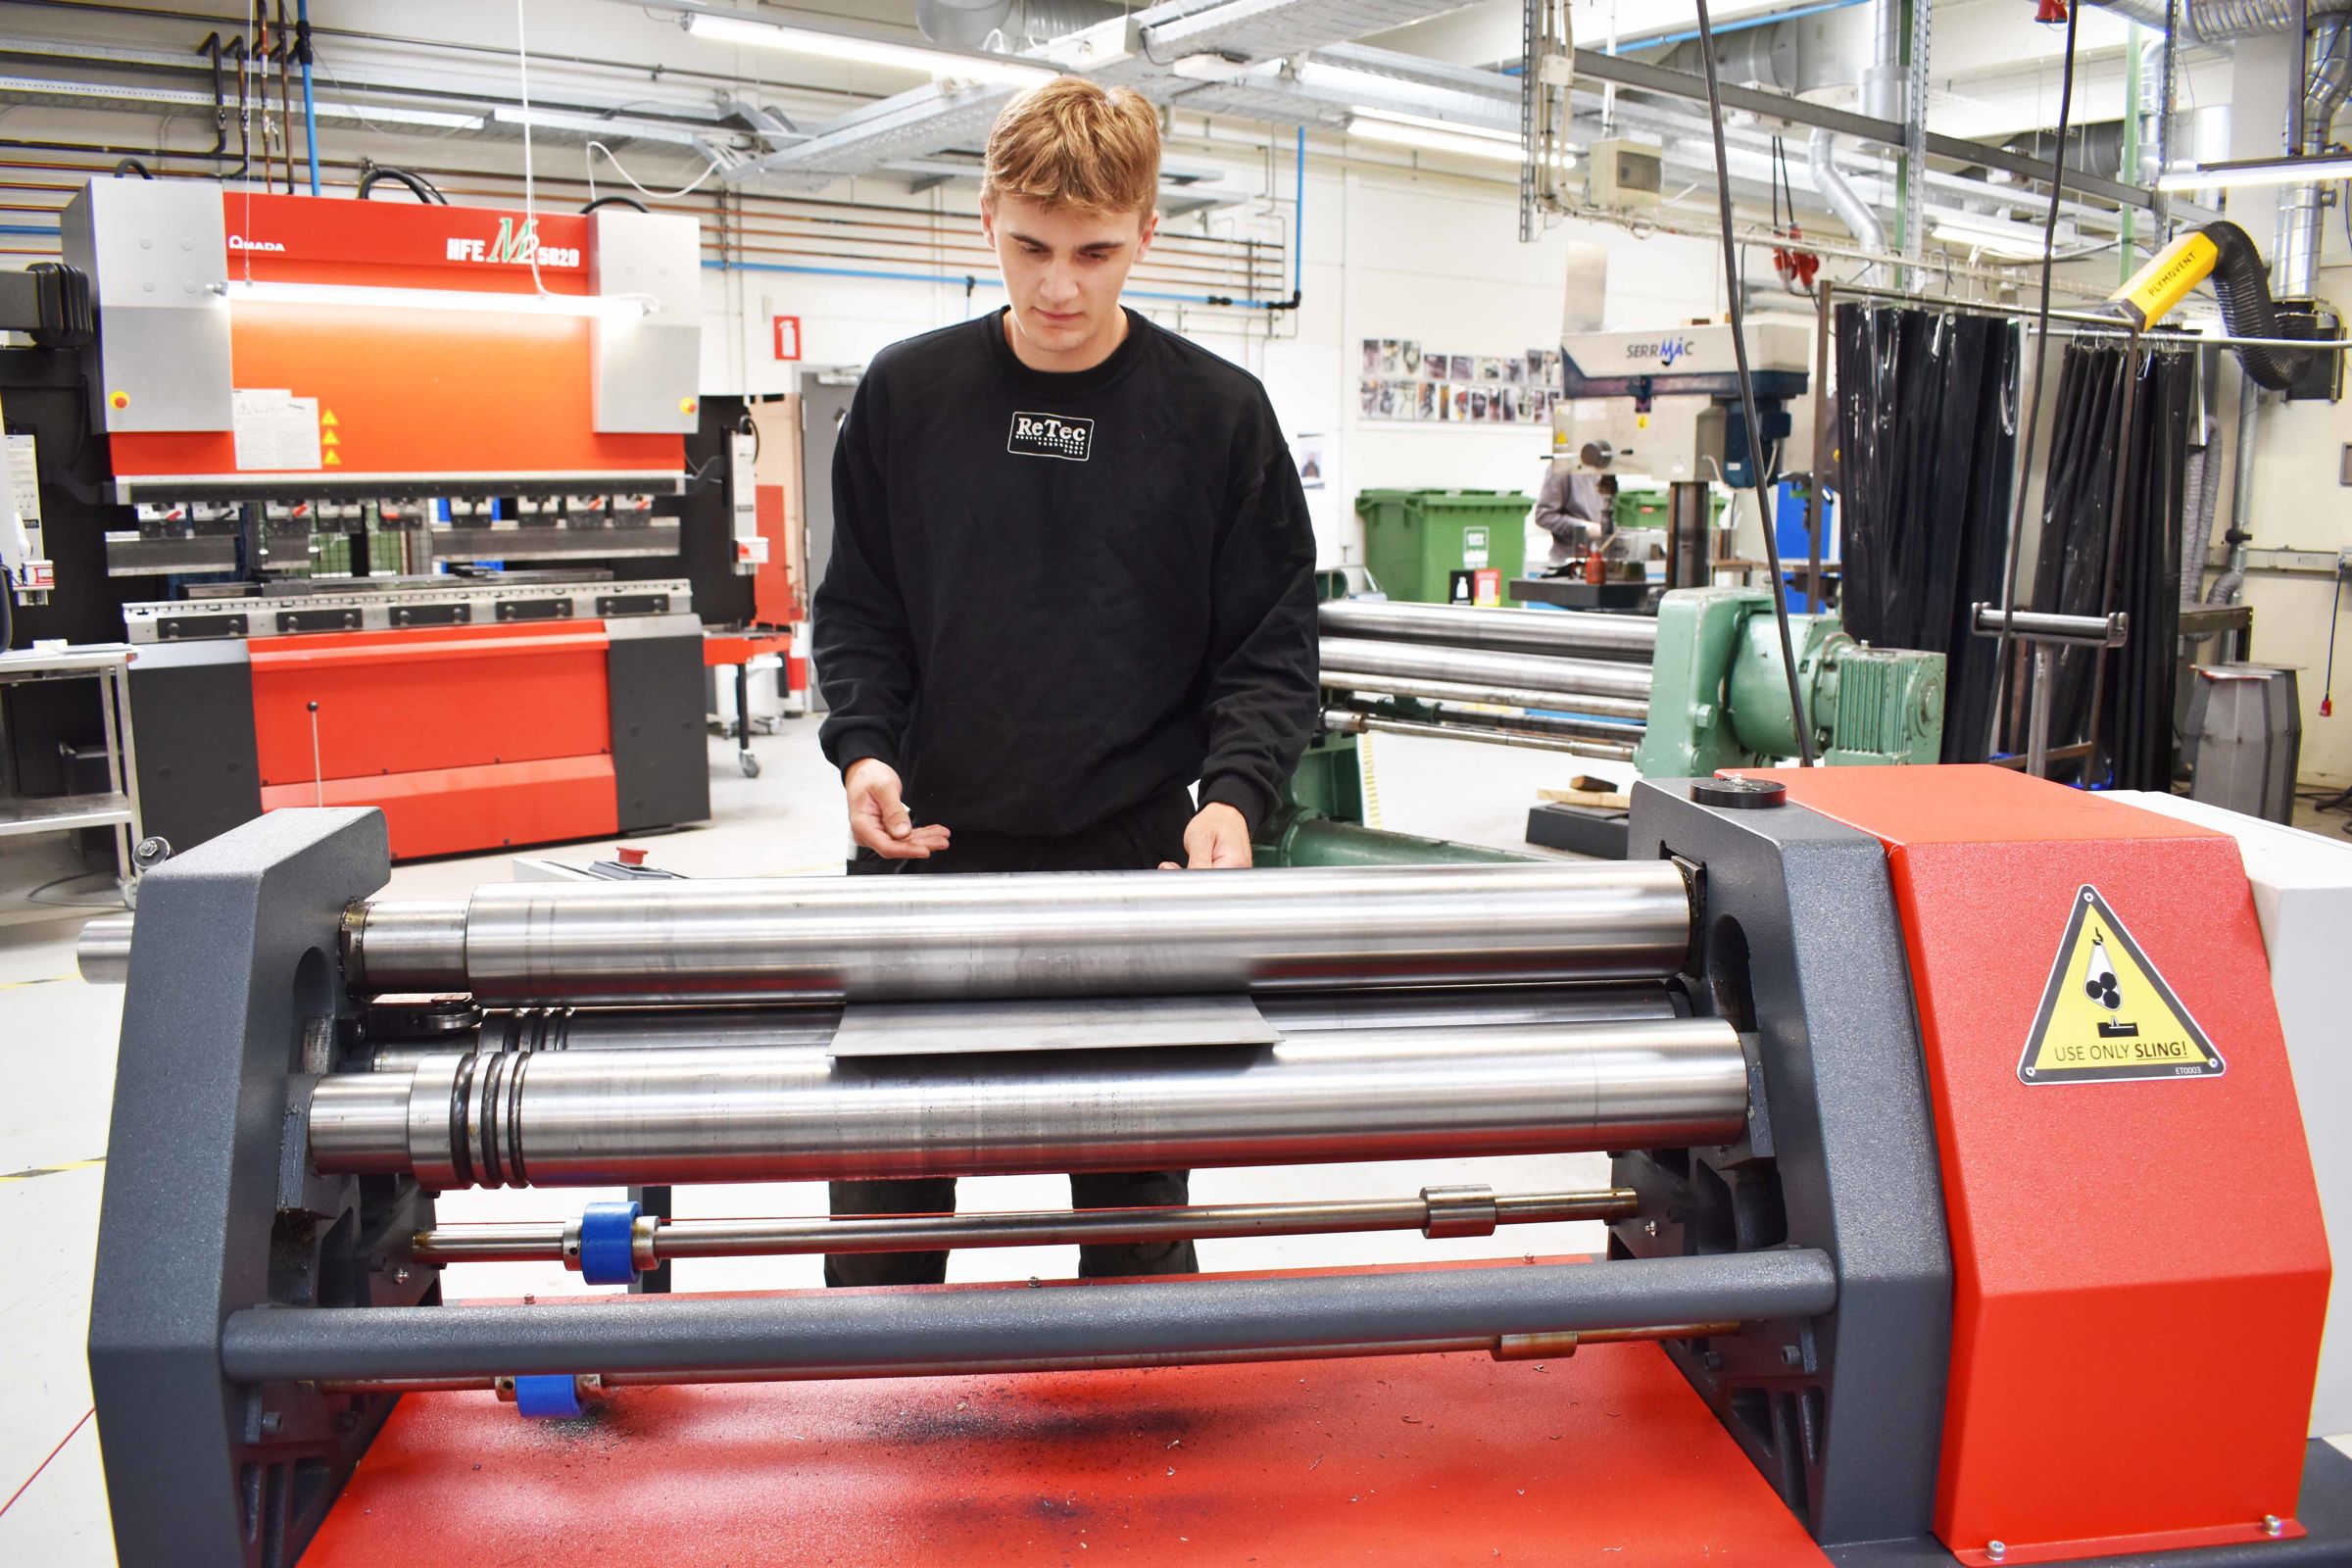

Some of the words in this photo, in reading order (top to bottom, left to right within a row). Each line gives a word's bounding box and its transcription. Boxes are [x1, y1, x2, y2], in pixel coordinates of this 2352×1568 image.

[446, 237, 486, 262] HFE
[2147, 251, 2196, 297] PLYMOVENT
[1016, 417, 1086, 441] ReTec
[2054, 1046, 2085, 1061] USE
[2089, 1044, 2130, 1059] ONLY
[2133, 1041, 2188, 1060] SLING!
[2175, 1065, 2202, 1075] ET0003
